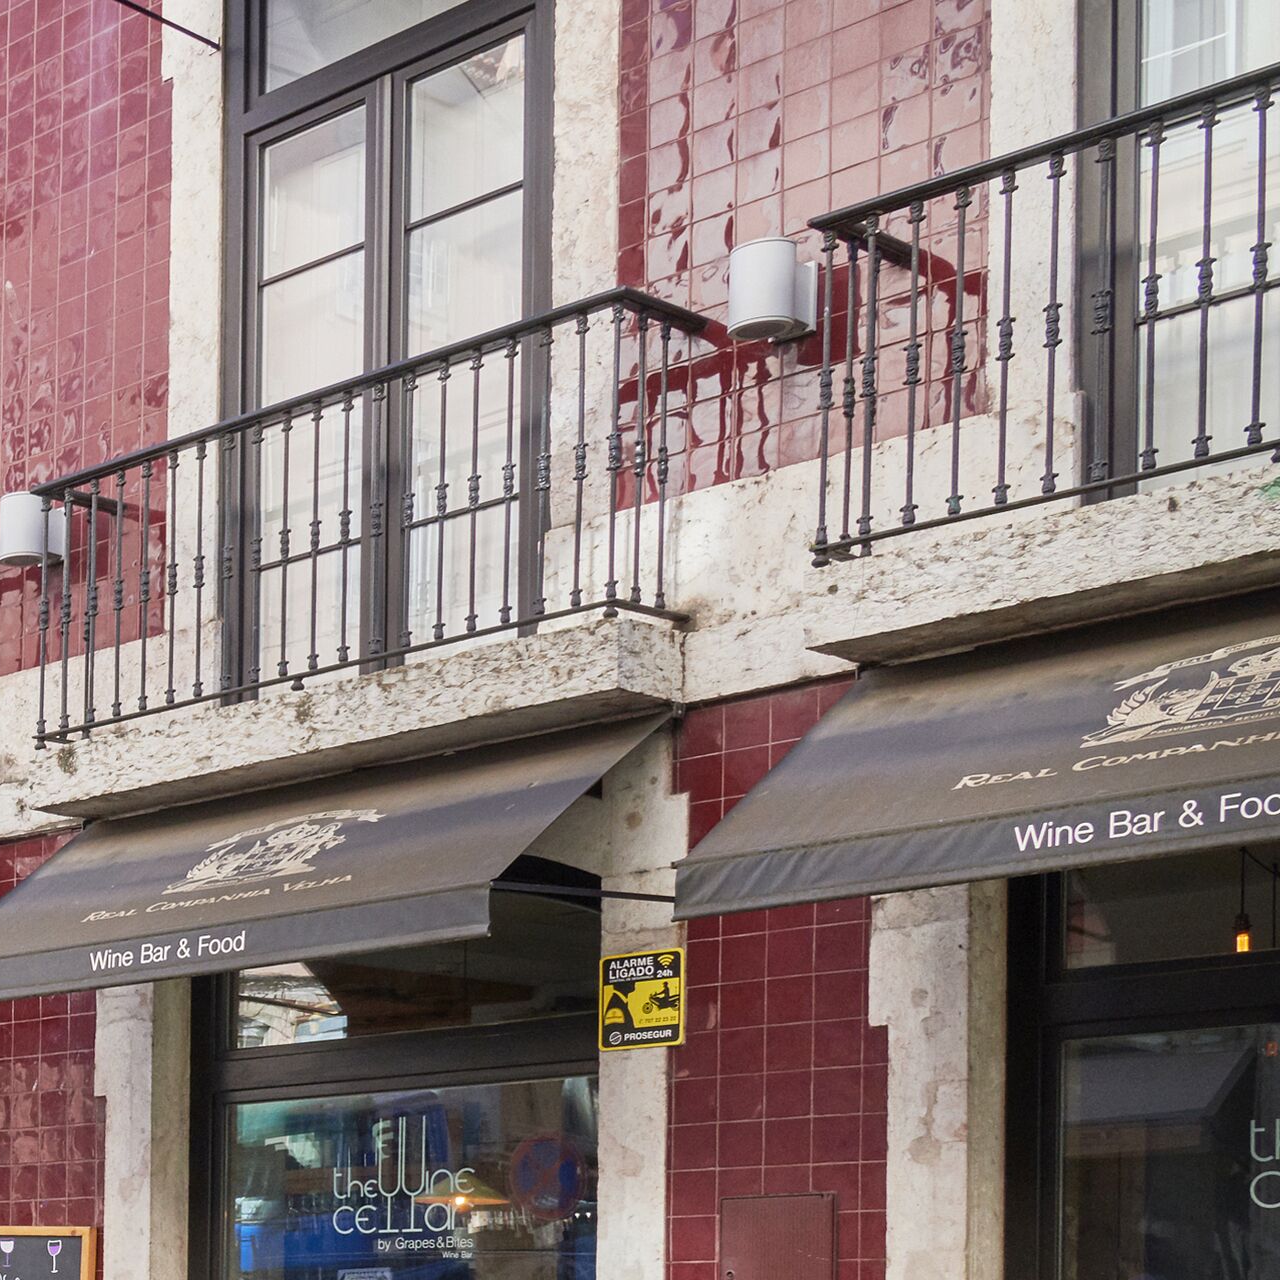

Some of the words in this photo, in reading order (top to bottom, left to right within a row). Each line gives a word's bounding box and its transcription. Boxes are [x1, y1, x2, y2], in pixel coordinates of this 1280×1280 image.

[951, 768, 1058, 790] REAL
[1014, 821, 1094, 852] Wine
[1109, 809, 1165, 838] Bar
[1178, 799, 1204, 829] &
[80, 910, 138, 923] REAL
[145, 887, 270, 913] COMPANHIA
[283, 875, 352, 893] VELHA
[90, 948, 133, 972] Wine
[140, 943, 170, 964] Bar
[177, 938, 191, 958] &
[198, 930, 246, 956] Food
[609, 956, 654, 970] ALARME
[609, 965, 654, 980] LIGADO
[656, 969, 673, 978] 24h
[624, 1029, 672, 1041] PROSEGUR
[333, 1165, 377, 1199] the
[377, 1238, 390, 1251] by
[442, 1251, 459, 1259] Wine
[461, 1251, 473, 1259] Bar
